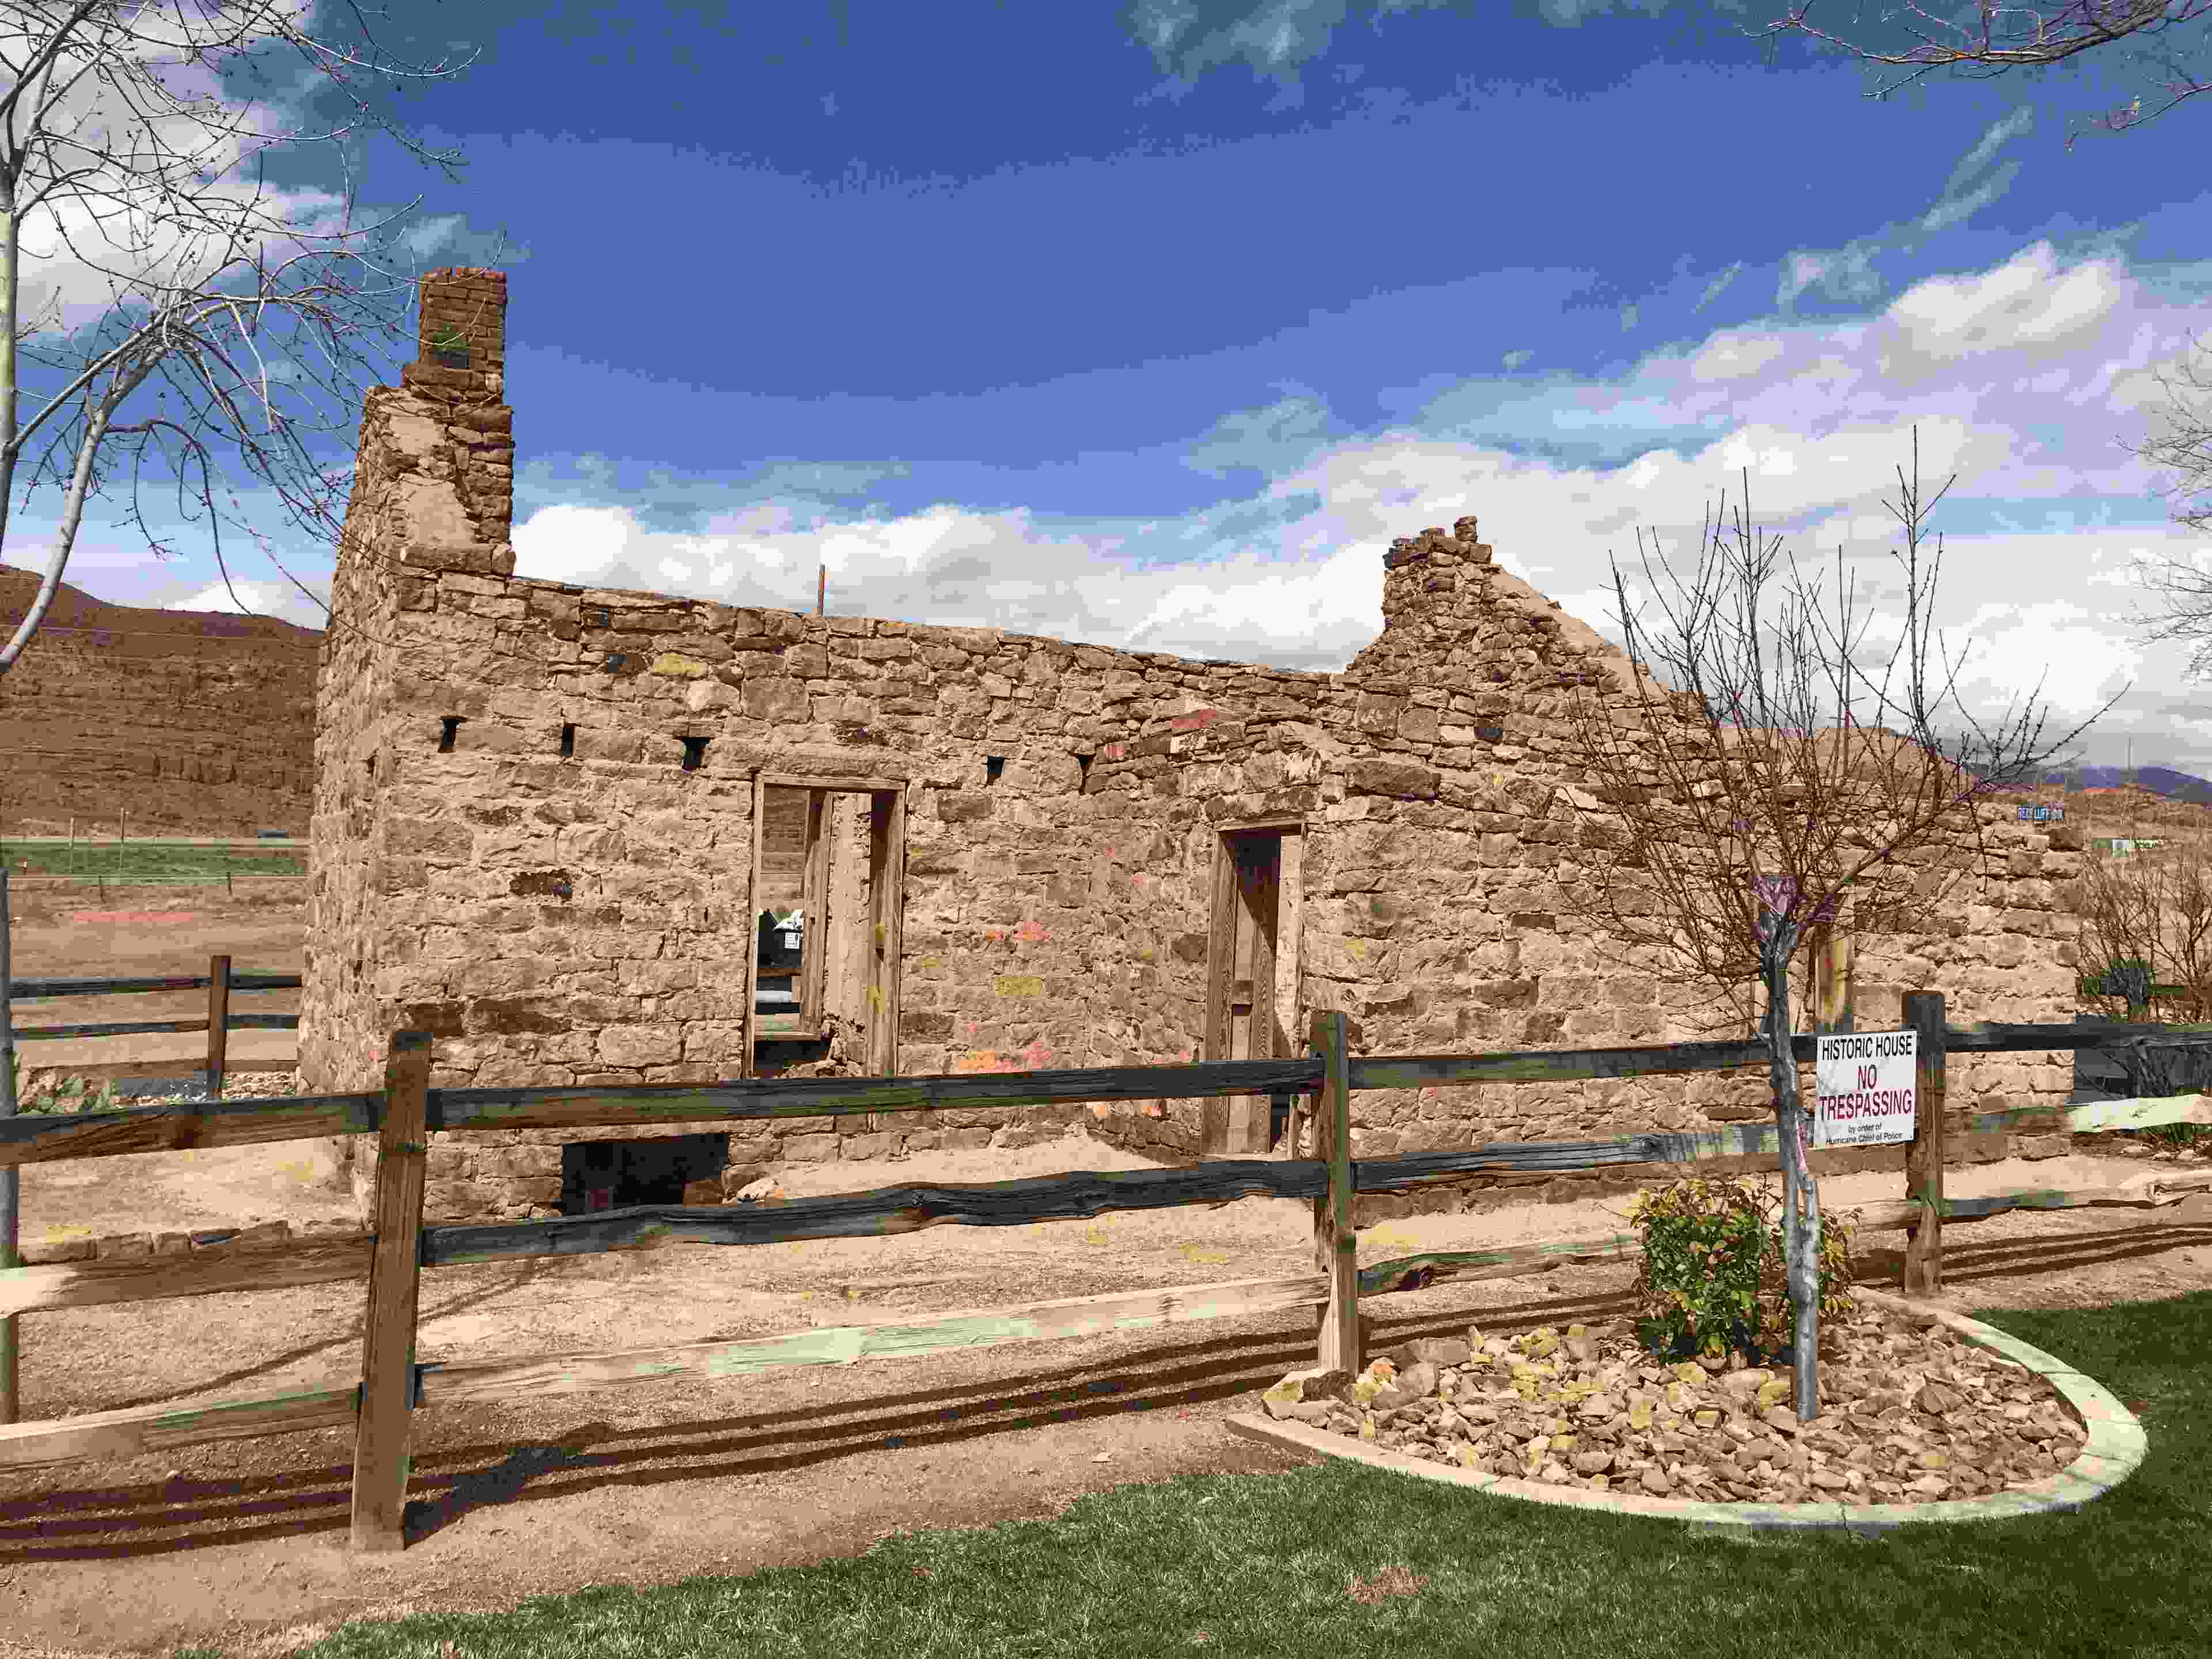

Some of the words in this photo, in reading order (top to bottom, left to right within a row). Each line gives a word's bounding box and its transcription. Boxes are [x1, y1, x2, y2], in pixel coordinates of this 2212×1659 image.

[1822, 1037, 1873, 1060] HISTORIC
[1876, 1035, 1912, 1057] HOUSE
[1858, 1064, 1878, 1090] NO
[1819, 1089, 1912, 1120] TRESPASSING
[1857, 1123, 1874, 1132] order
[1875, 1121, 1882, 1130] of
[1884, 1130, 1903, 1140] Police
